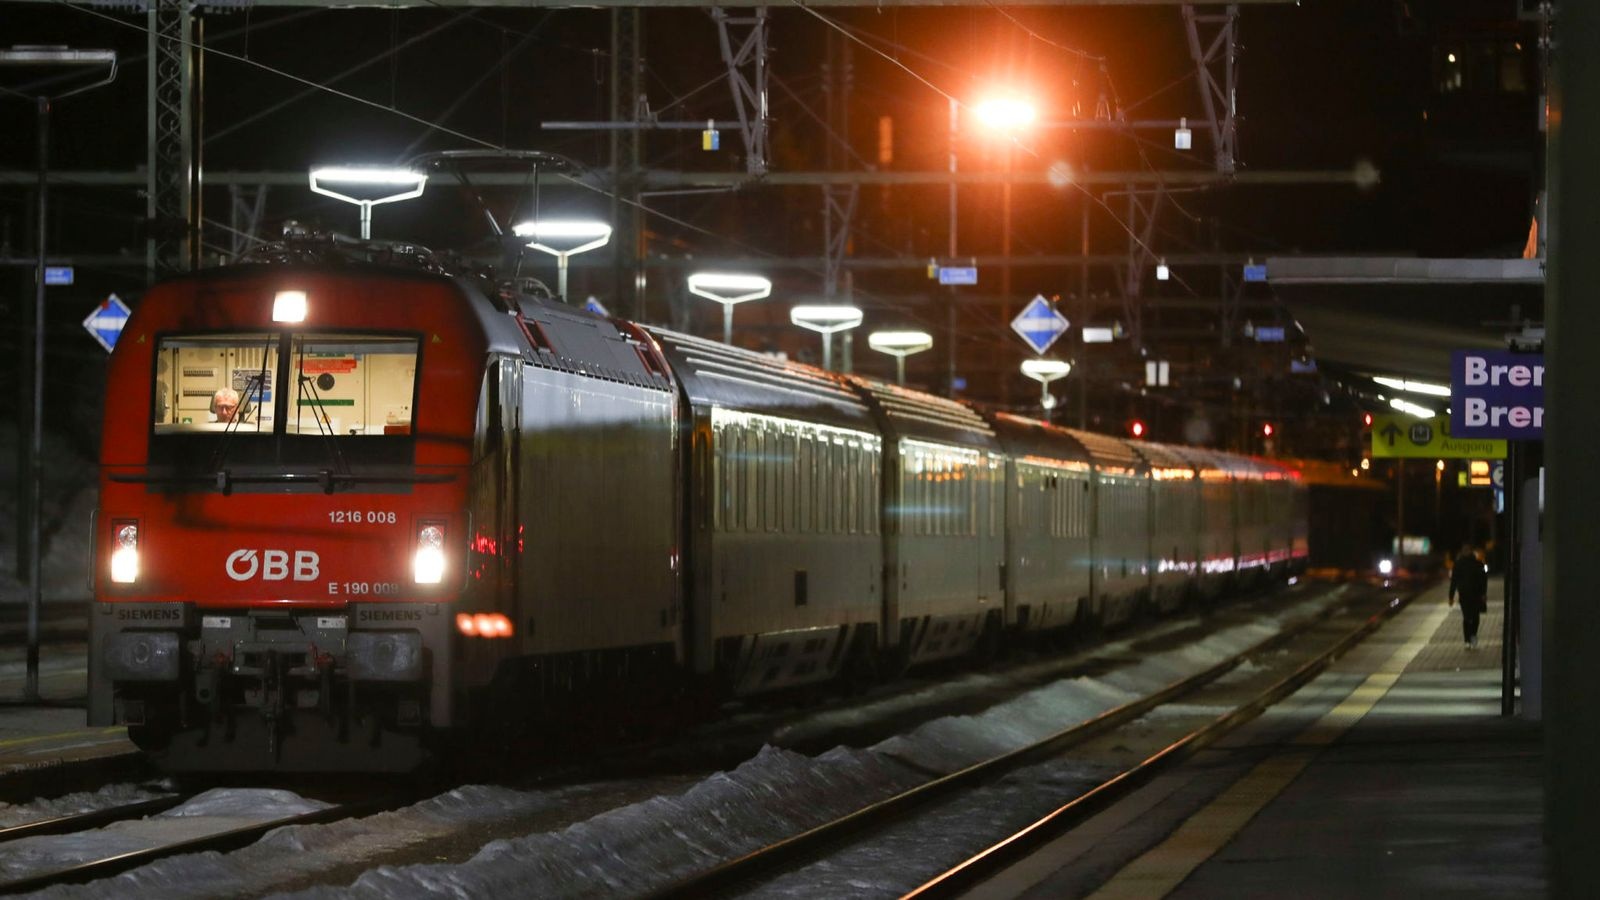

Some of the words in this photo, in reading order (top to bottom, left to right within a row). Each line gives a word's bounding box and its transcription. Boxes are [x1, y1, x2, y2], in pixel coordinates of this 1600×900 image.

[1441, 440, 1493, 453] Ausgang
[328, 511, 362, 523] 1216
[367, 511, 397, 524] 008
[225, 549, 320, 581] ÖBB
[328, 582, 338, 594] E
[343, 582, 369, 594] 190
[117, 608, 181, 620] SIEMENS
[359, 609, 422, 621] SIEMENS
